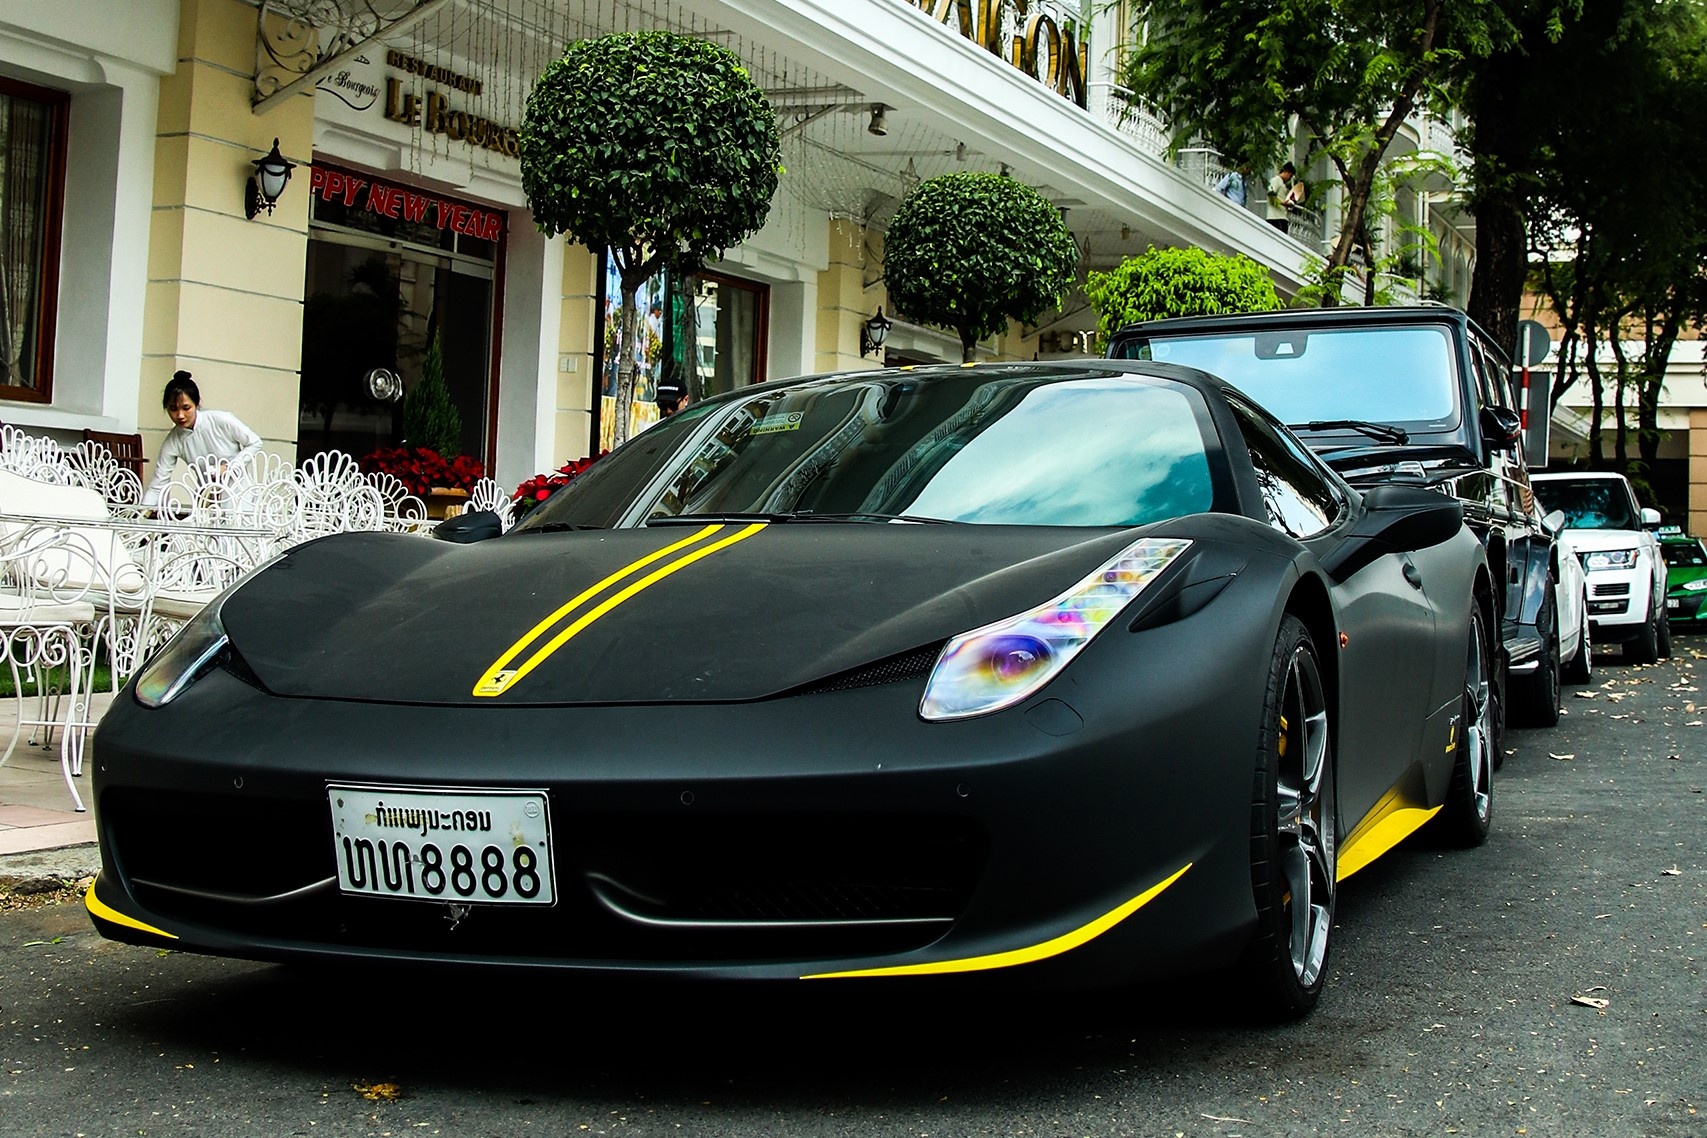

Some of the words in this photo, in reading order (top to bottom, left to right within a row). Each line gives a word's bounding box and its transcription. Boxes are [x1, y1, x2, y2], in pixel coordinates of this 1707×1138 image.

[334, 70, 379, 99] Bourgeois
[386, 49, 484, 96] RESTAURANT
[366, 183, 430, 224] NEW
[436, 200, 502, 242] YEAR
